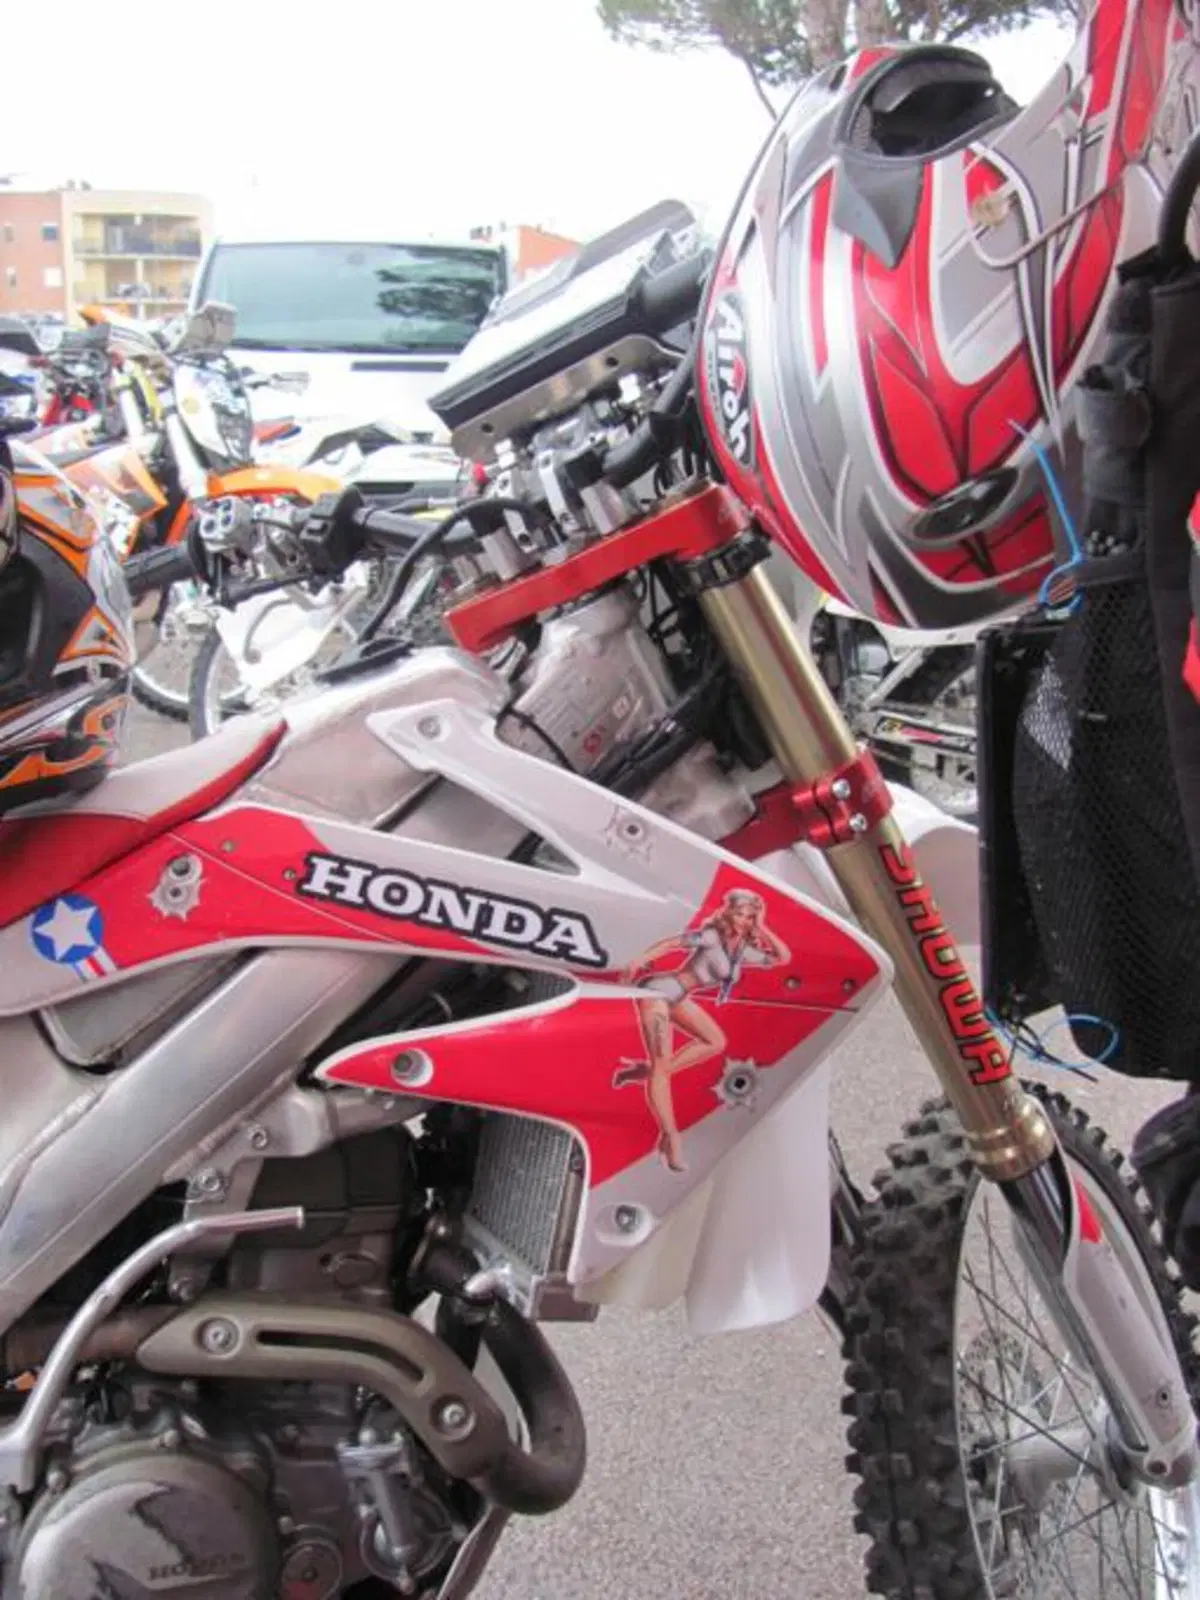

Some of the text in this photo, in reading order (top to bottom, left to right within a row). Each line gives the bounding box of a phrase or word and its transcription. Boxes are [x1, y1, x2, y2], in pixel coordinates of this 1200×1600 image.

[717, 301, 749, 460] Airoh
[299, 854, 606, 966] HONDA
[878, 843, 1013, 1086] SHOWA
